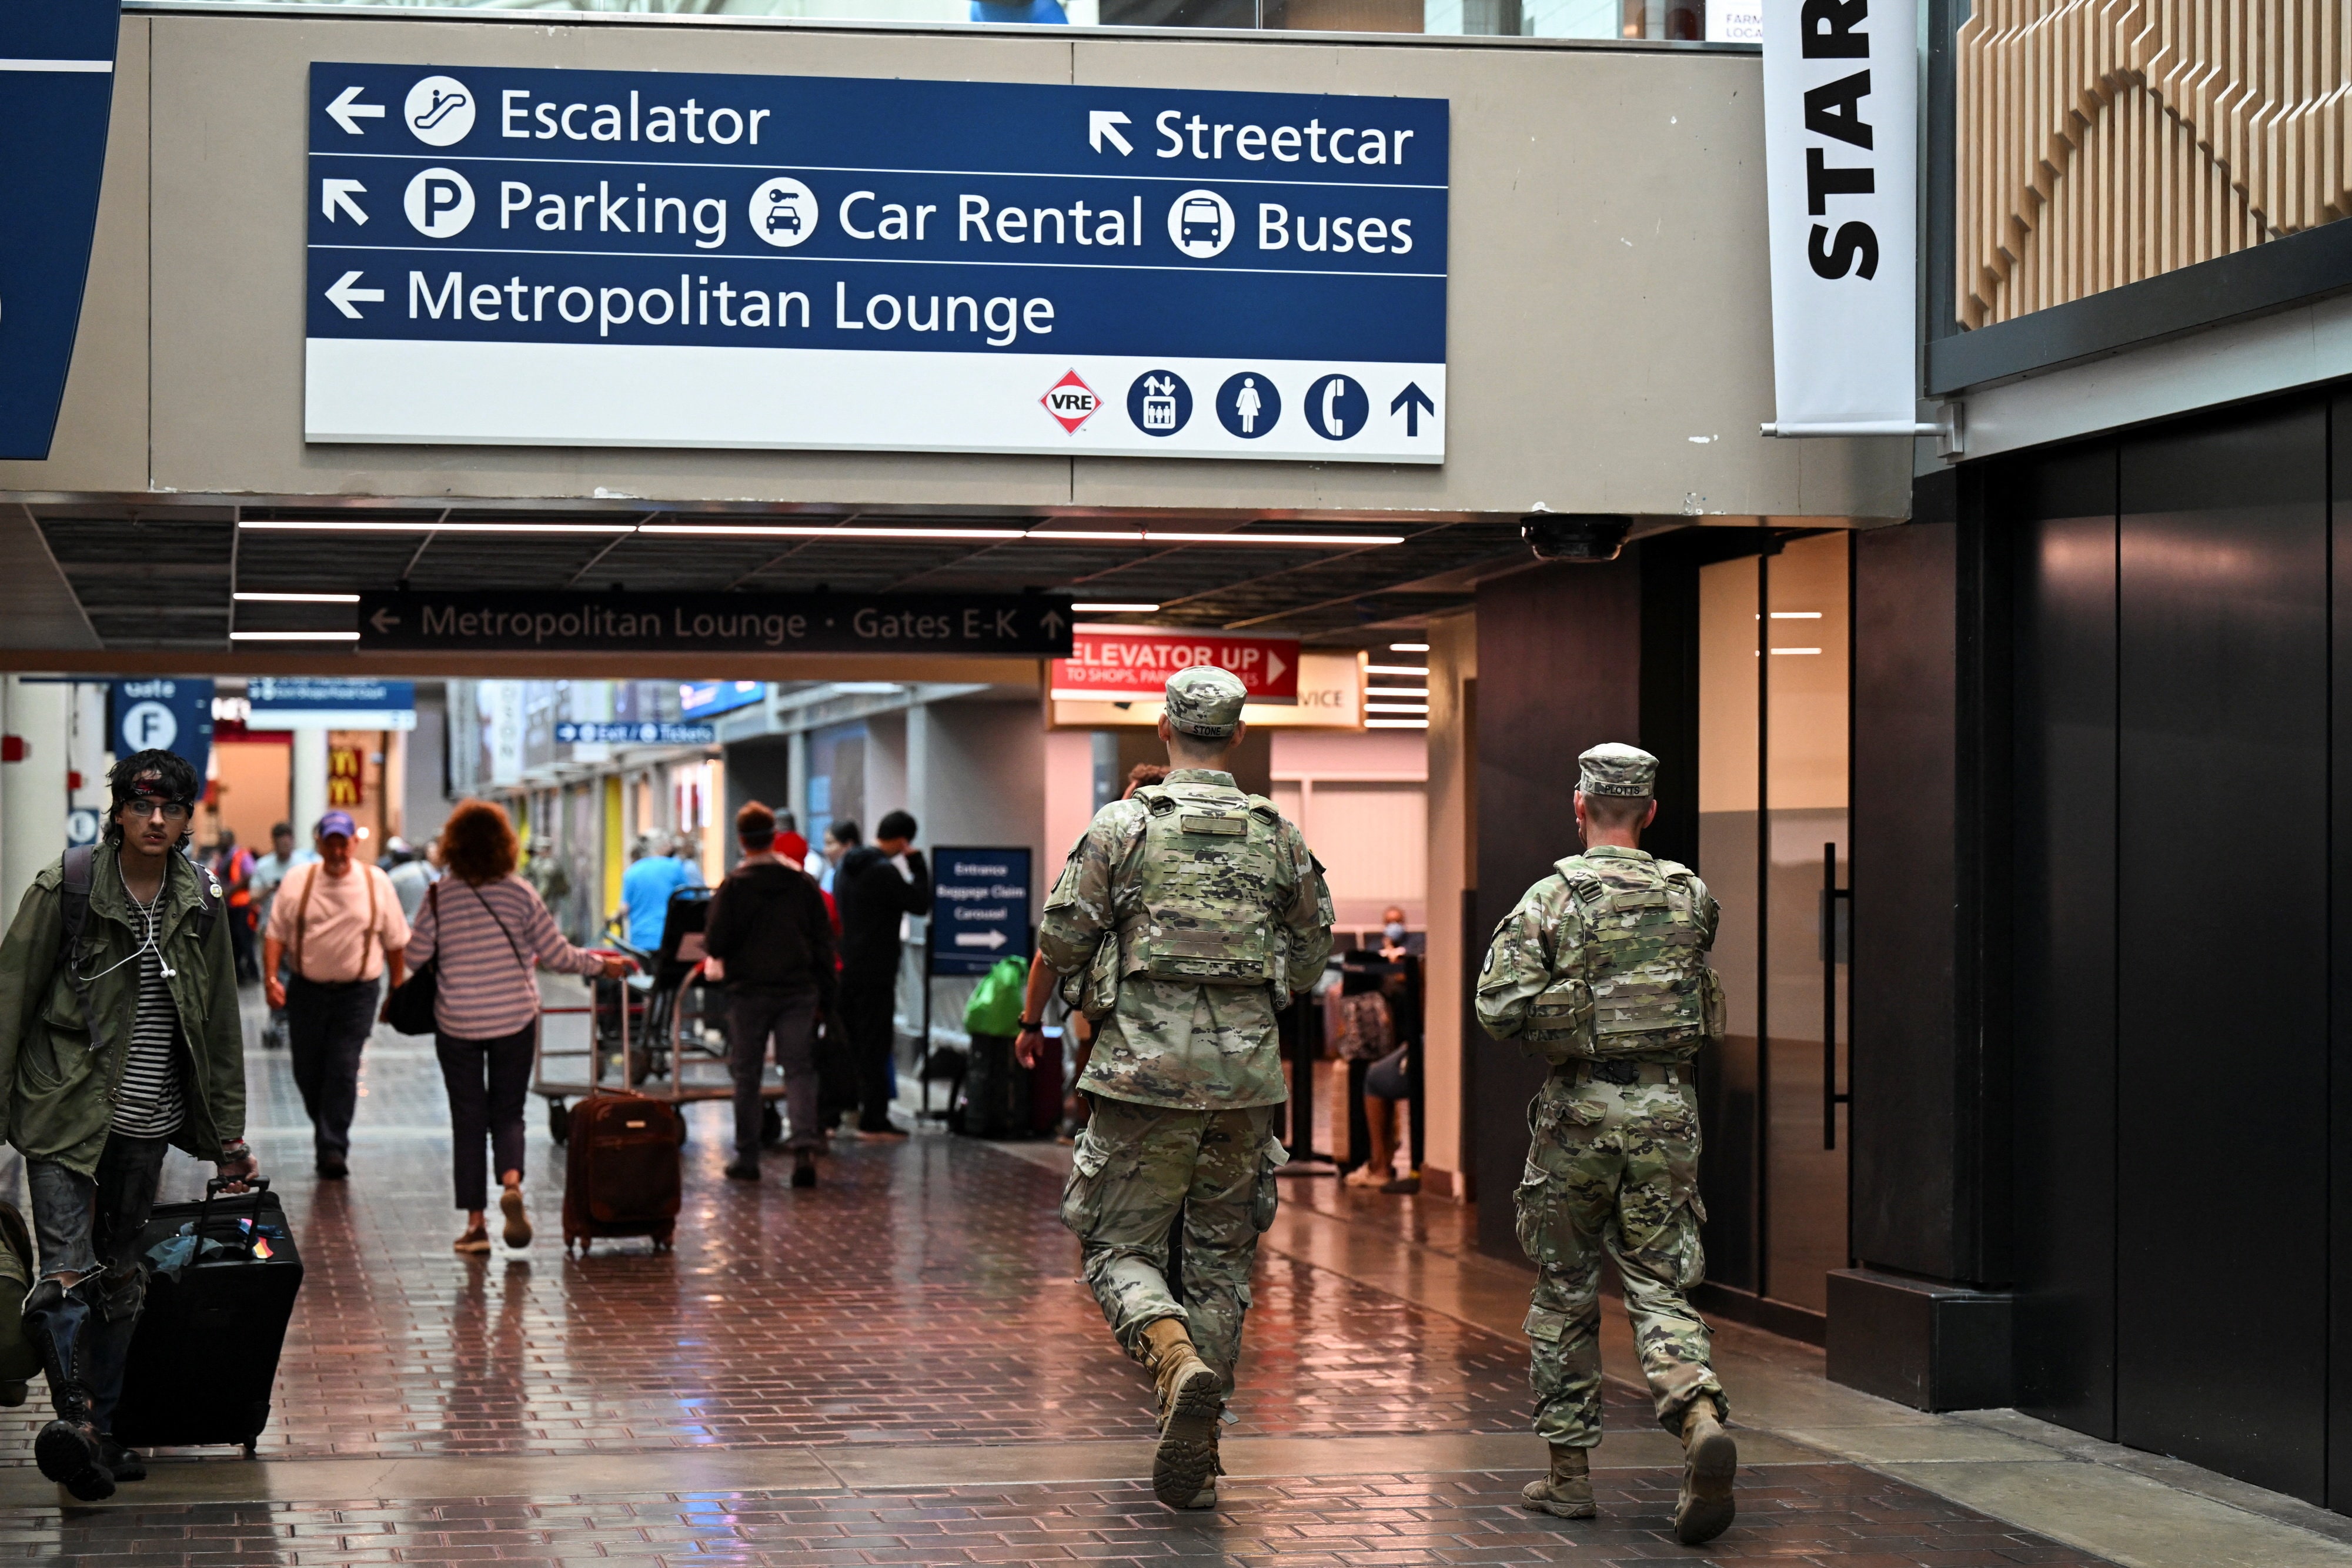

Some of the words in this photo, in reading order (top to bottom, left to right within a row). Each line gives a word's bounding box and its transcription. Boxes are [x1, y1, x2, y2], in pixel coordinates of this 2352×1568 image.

[502, 89, 770, 145] Escalator
[1156, 110, 1414, 165] Streetcar
[501, 180, 726, 249] Parking
[839, 190, 937, 240] Car
[959, 194, 1141, 246] Rental
[1259, 203, 1413, 254] Buses
[409, 270, 810, 337] Metropolitan
[836, 281, 1055, 346] Lounge
[1051, 394, 1092, 410] VRE
[422, 605, 661, 644] Metropolitan
[675, 607, 807, 646] Lounge
[853, 607, 951, 638] Gates
[963, 609, 1018, 638] E-K
[1065, 642, 1214, 668] ELEVATOR
[1221, 647, 1260, 670] UP
[1066, 667, 1086, 682] TO
[1297, 690, 1344, 708] VICE
[141, 710, 161, 744] F
[1193, 726, 1221, 735] STONE
[1605, 785, 1640, 794] PLOTTS
